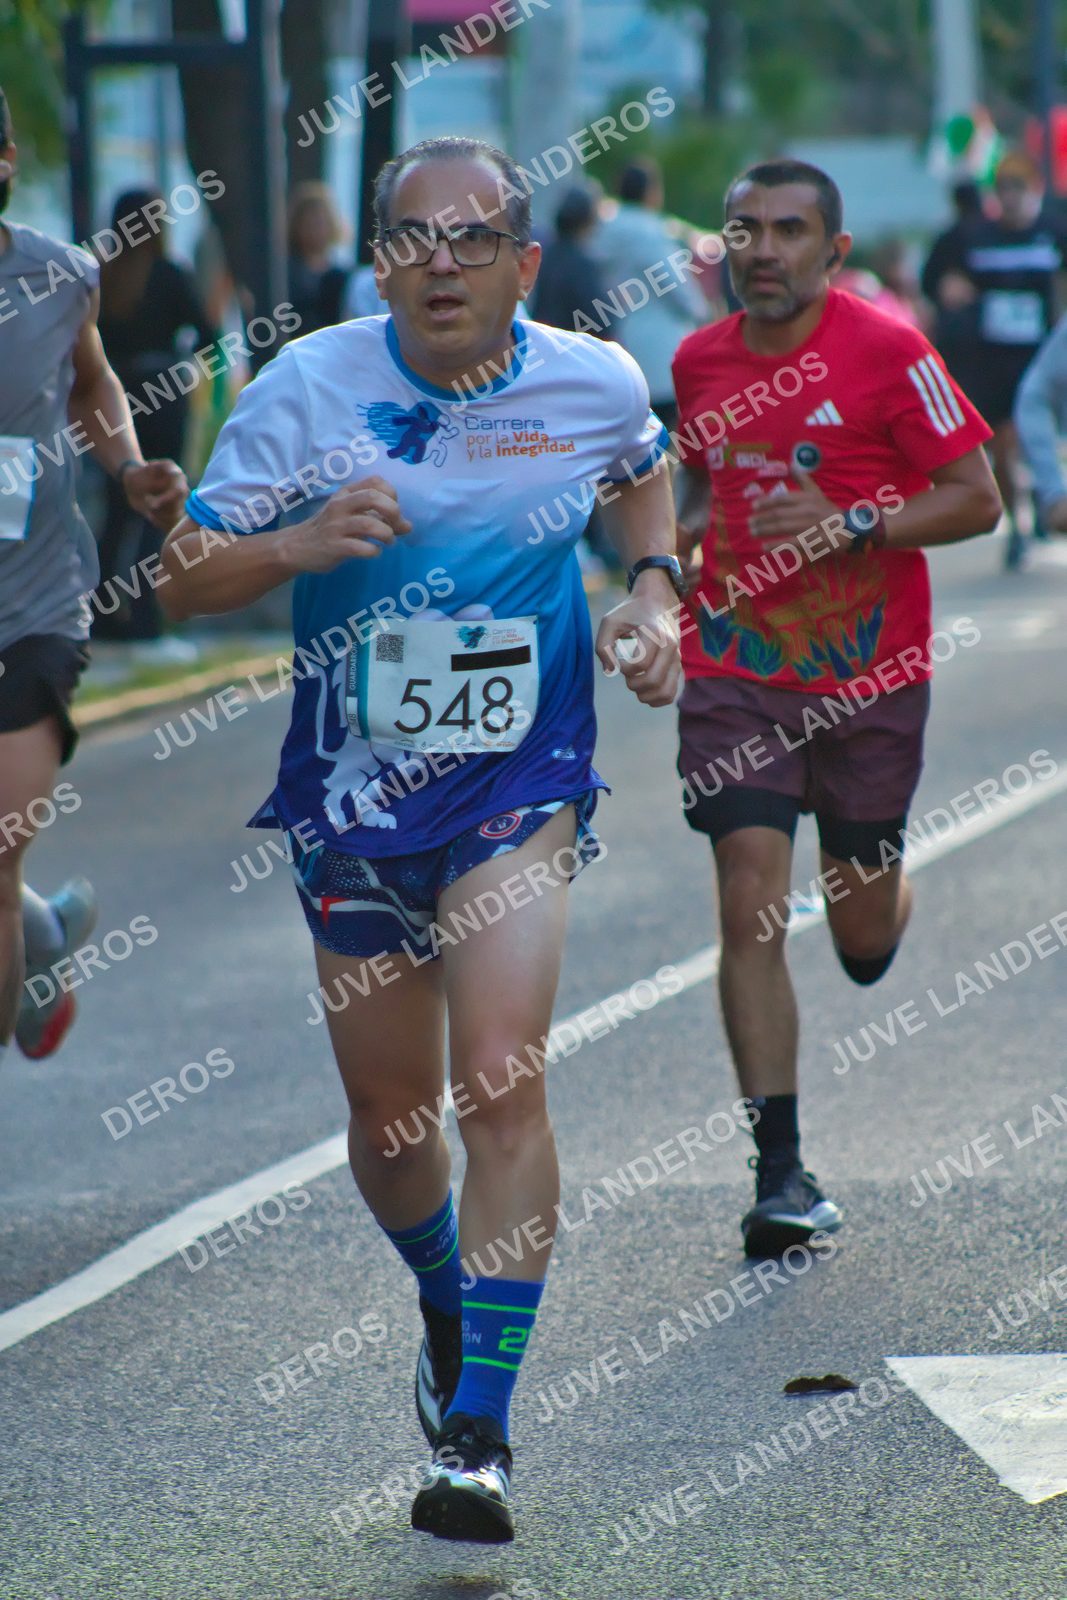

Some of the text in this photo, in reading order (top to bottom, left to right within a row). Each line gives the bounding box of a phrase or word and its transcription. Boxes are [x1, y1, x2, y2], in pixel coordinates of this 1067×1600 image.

[464, 416, 545, 430] Carrera
[466, 431, 549, 450] por la Vida
[466, 449, 475, 462] y
[480, 445, 492, 458] la
[394, 676, 515, 735] 548
[498, 1325, 533, 1354] 2
